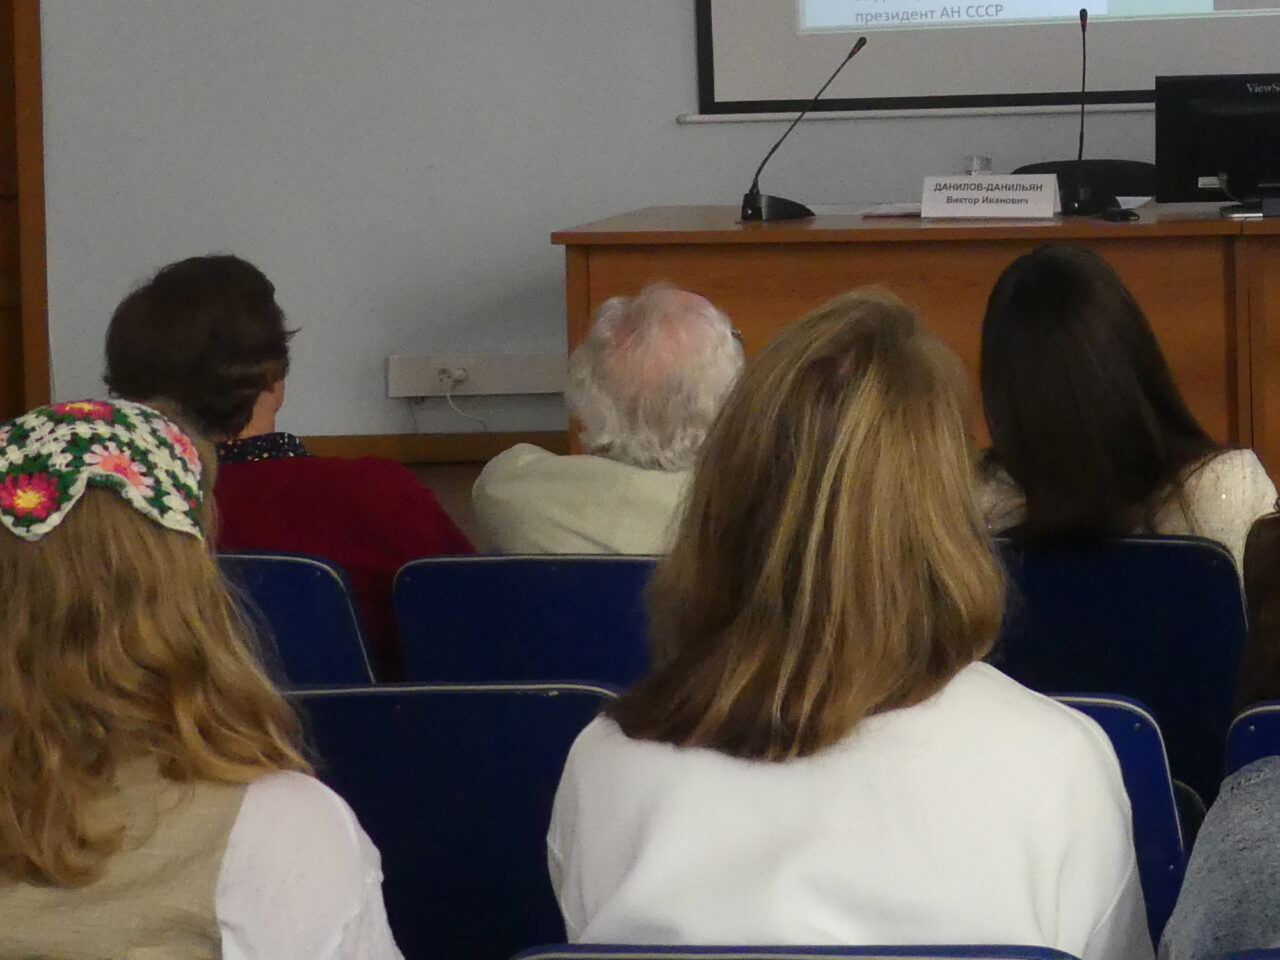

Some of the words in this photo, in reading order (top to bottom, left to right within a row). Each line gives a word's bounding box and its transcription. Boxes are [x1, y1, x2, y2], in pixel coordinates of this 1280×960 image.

[855, 8, 936, 25] президент
[940, 6, 961, 20] АН
[965, 4, 1004, 19] СССР
[933, 182, 1043, 193] ДАНИЛОВ-ДАНИЛЬЯН
[946, 196, 980, 205] Виктор
[981, 195, 1029, 205] Иванович
